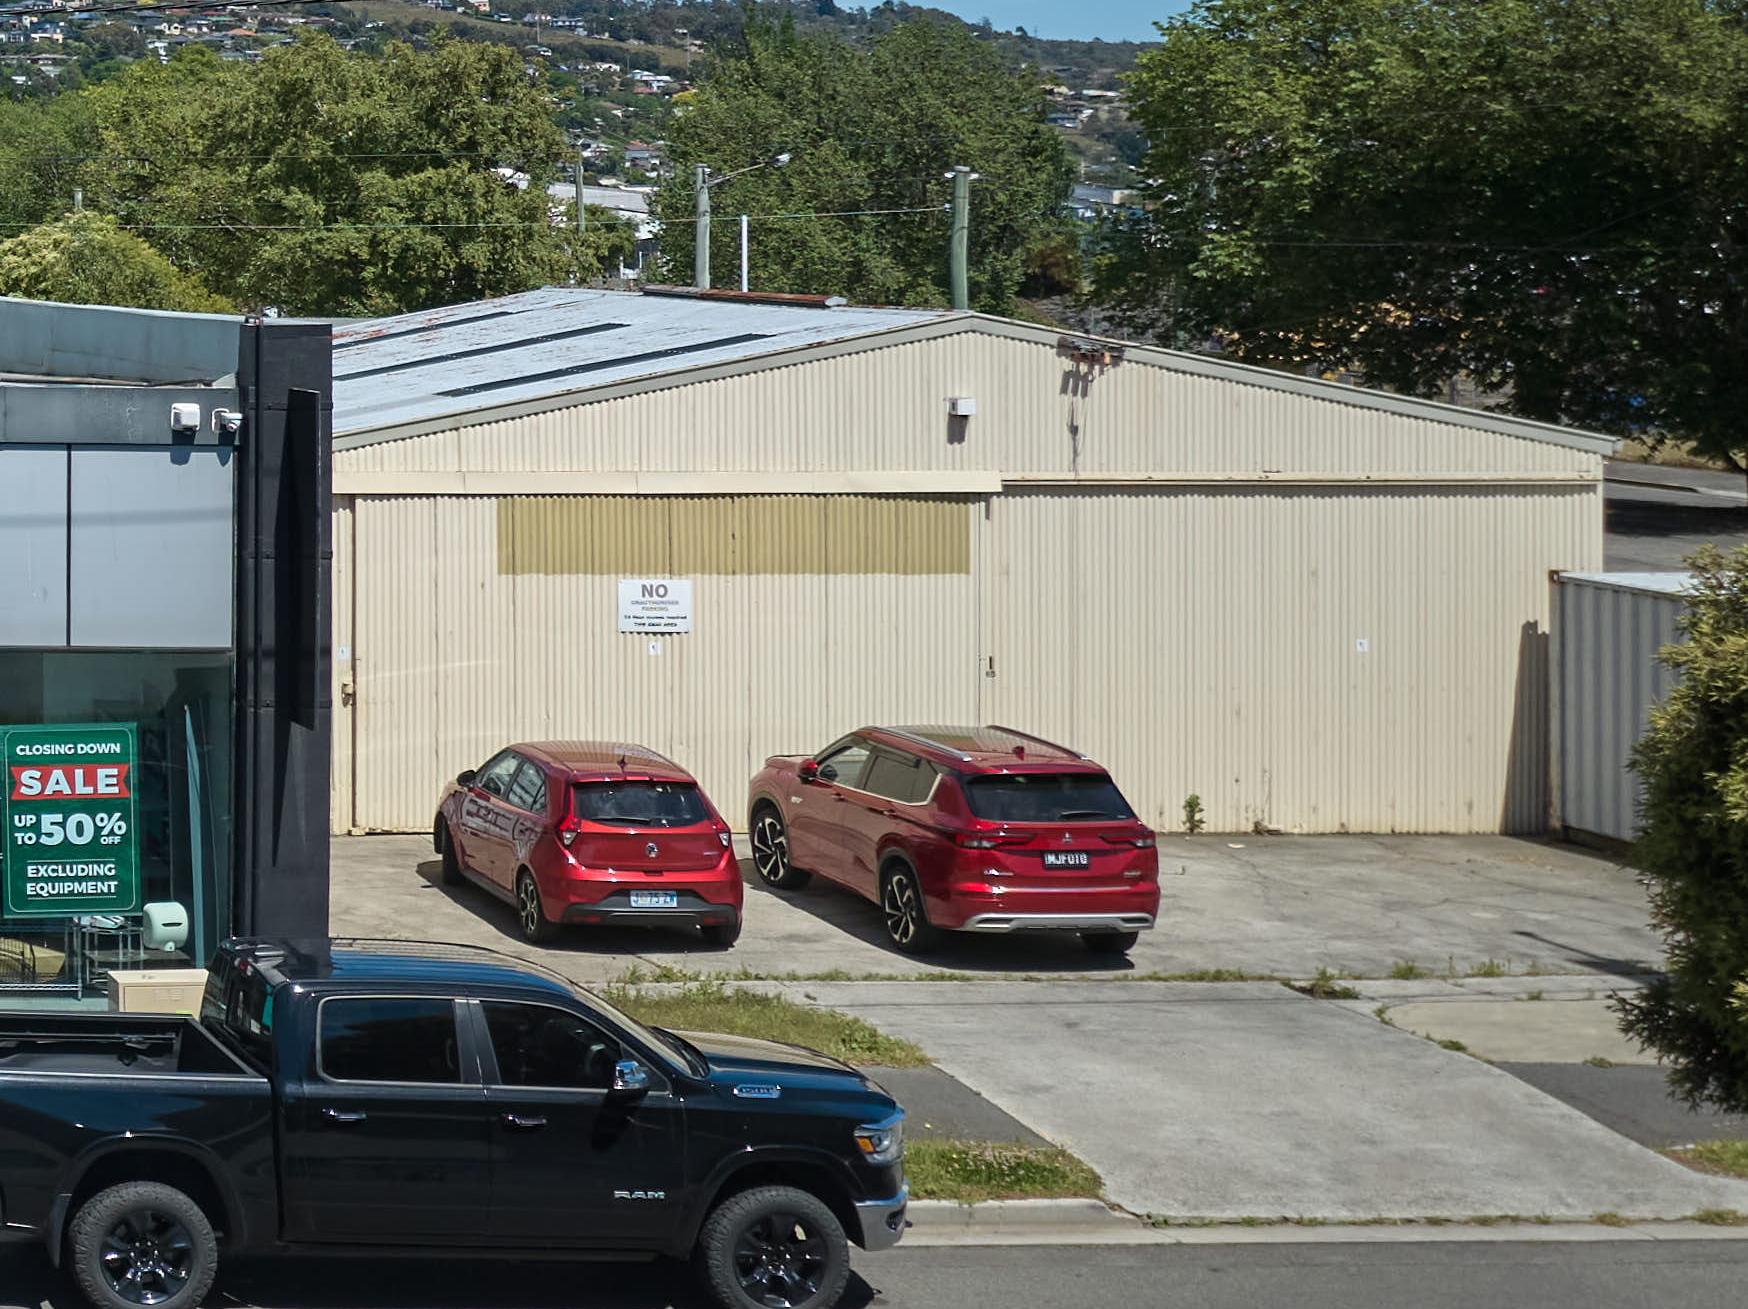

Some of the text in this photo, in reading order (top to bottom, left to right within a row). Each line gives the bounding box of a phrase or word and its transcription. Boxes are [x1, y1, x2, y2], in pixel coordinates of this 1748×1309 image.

[641, 584, 668, 598] NO
[16, 743, 121, 755] CLOSING DOWN
[20, 768, 119, 795] SALE
[14, 815, 36, 827] UP
[14, 813, 127, 846] TO 50%
[100, 837, 121, 845] OFF
[27, 864, 116, 877] EXCLUDING
[26, 882, 118, 896] EQUIPMENT
[614, 1191, 665, 1199] RAM
